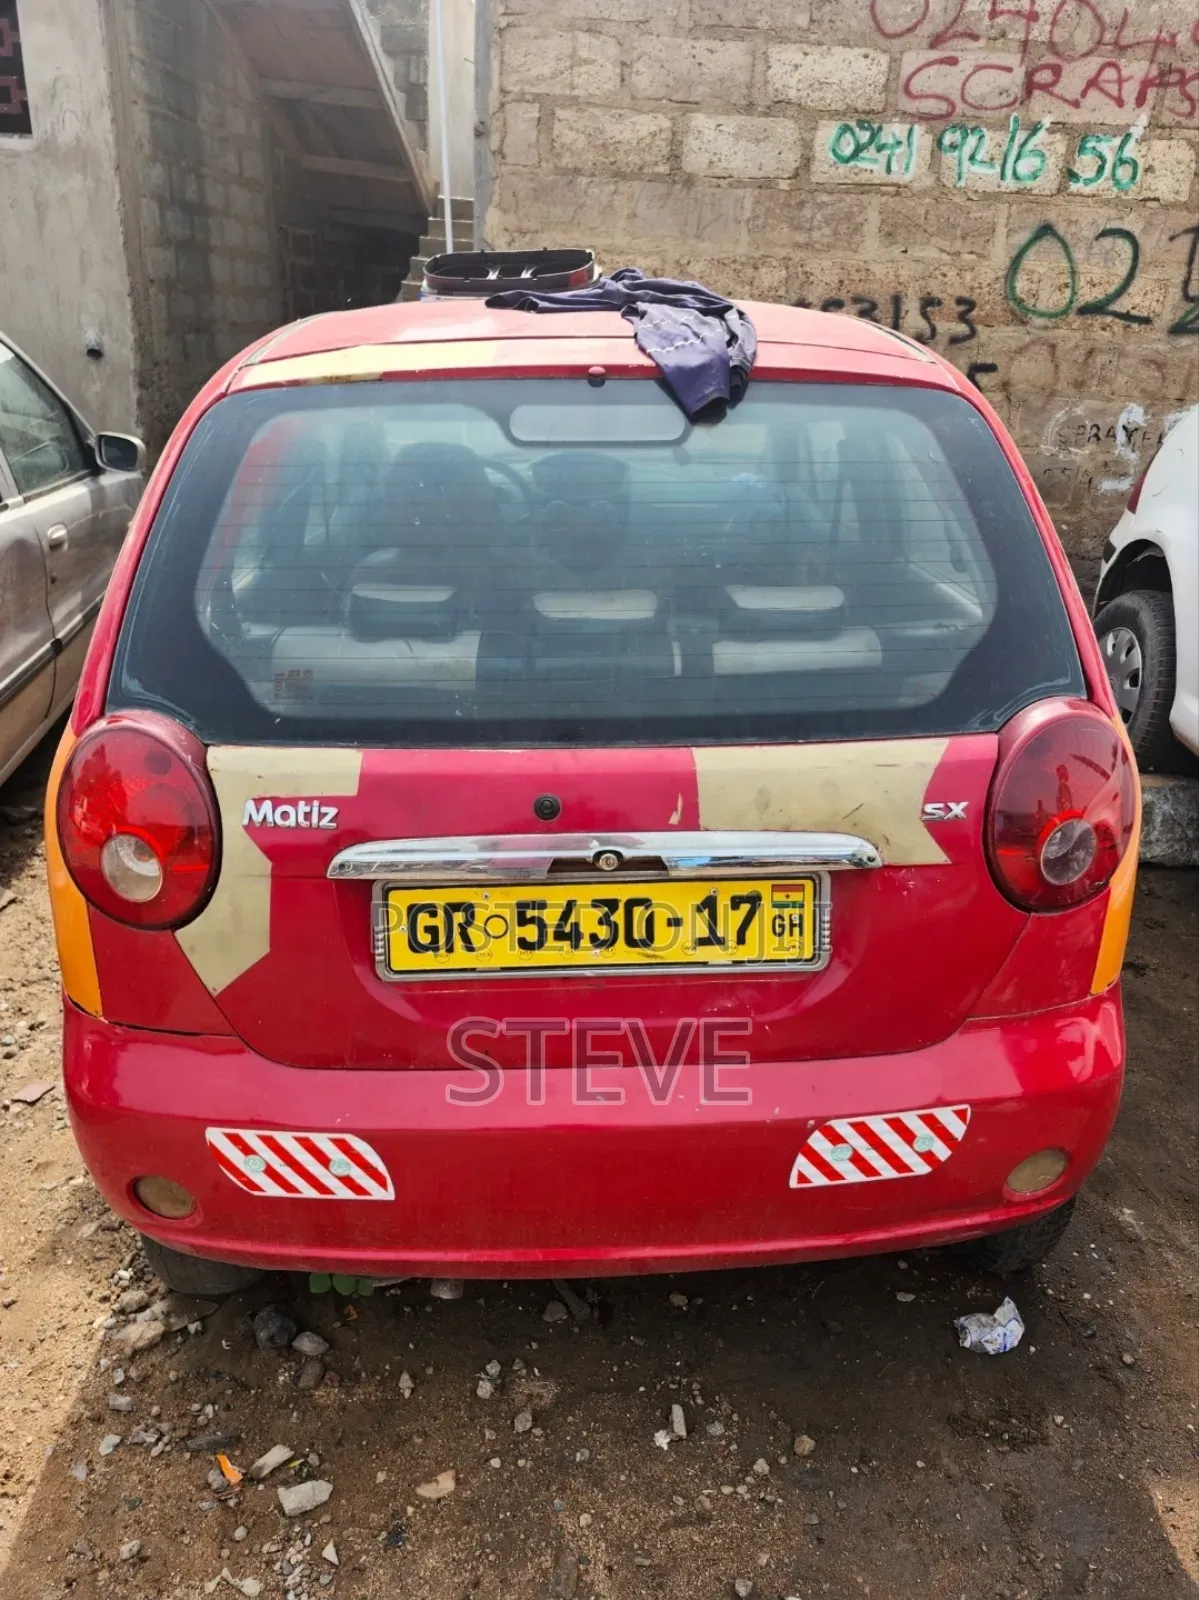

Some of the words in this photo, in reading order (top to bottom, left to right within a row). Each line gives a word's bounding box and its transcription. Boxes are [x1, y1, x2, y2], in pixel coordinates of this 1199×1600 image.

[1067, 122, 1142, 191] 56
[242, 800, 339, 829] Matiz
[921, 801, 969, 820] SX
[407, 902, 476, 953] GR
[516, 889, 763, 951] 5430-17
[772, 913, 803, 937] GH
